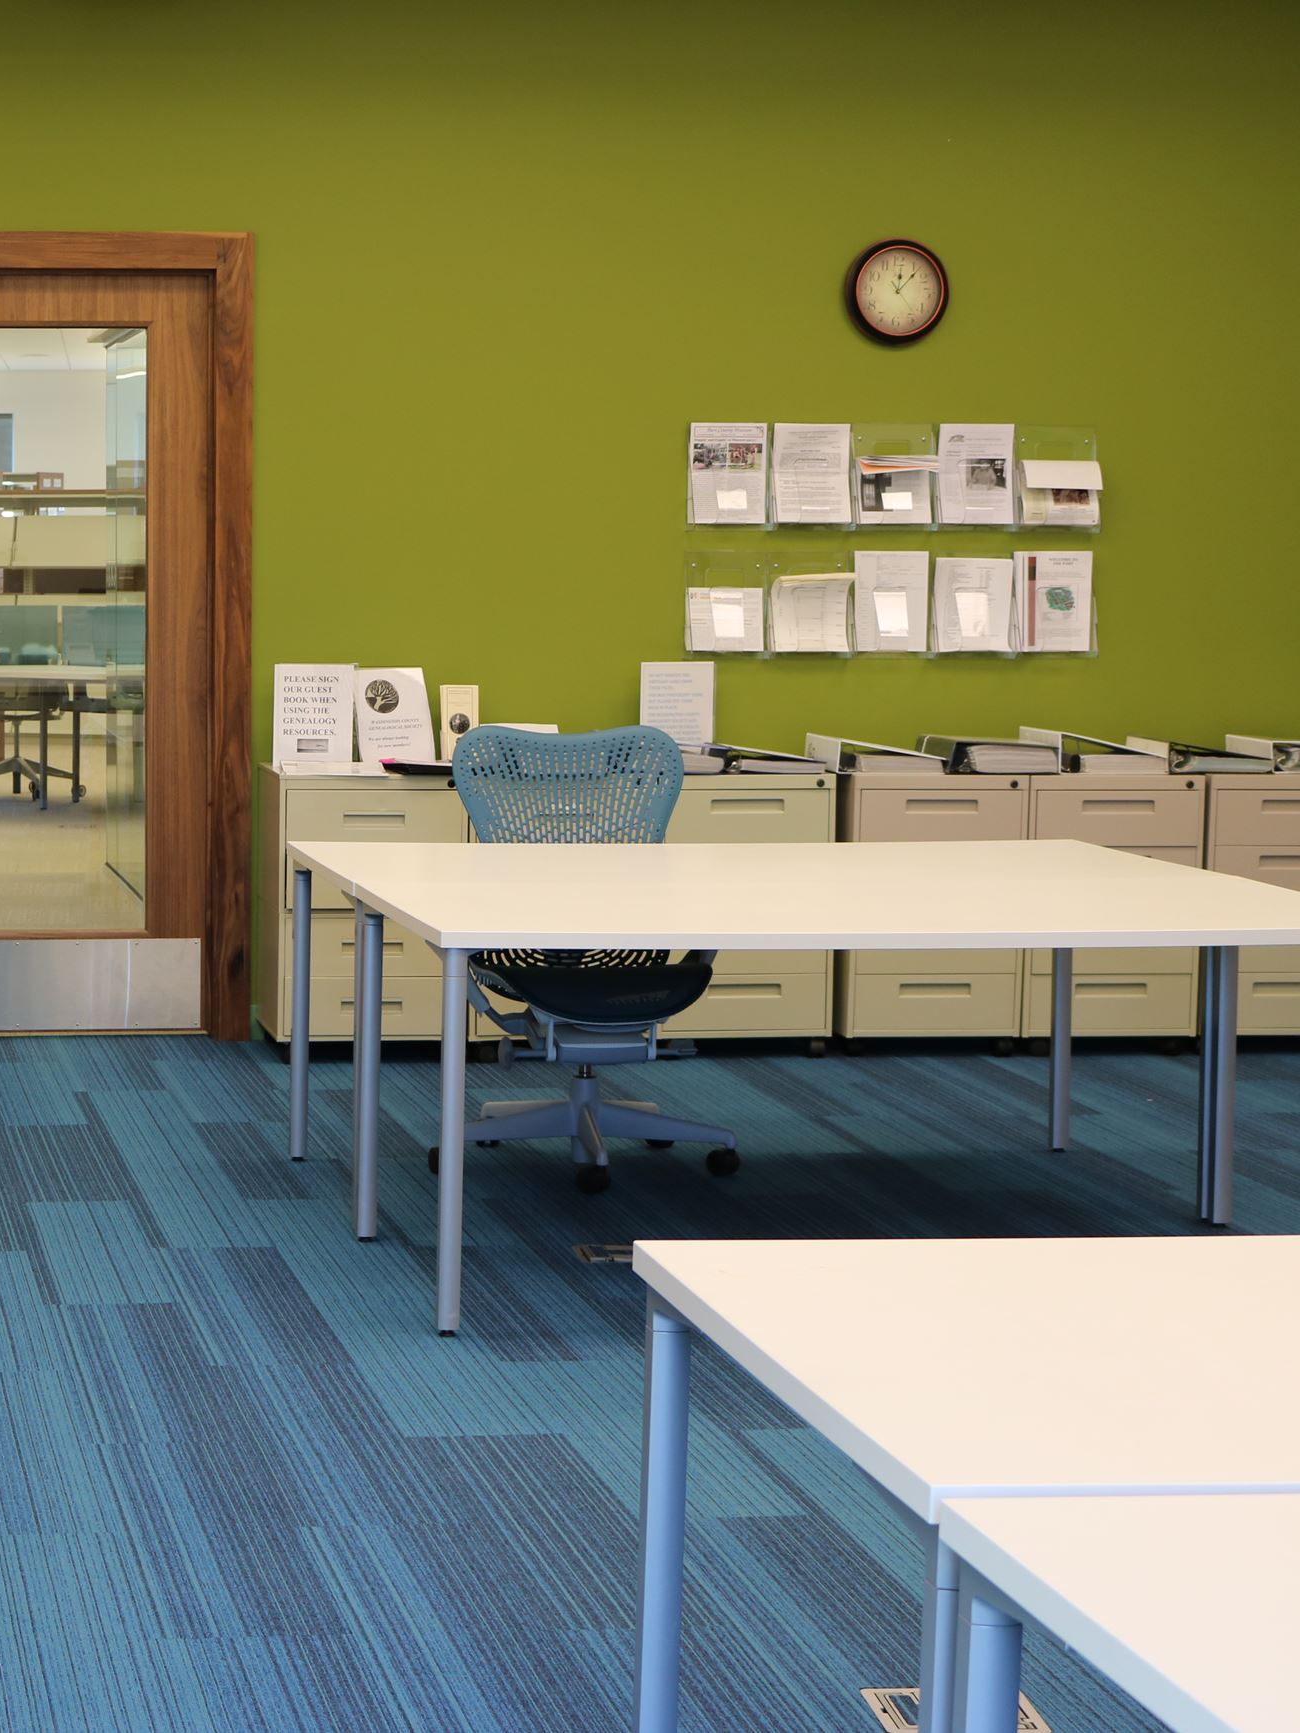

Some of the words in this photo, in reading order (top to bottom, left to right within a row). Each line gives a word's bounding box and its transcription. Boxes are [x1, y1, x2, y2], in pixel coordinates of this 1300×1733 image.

[882, 261, 889, 271] 11
[893, 255, 905, 267] 12
[869, 271, 881, 282] 10
[920, 272, 928, 284] 2
[865, 286, 873, 296] 9
[868, 300, 876, 311] 8
[916, 302, 924, 314] 4
[891, 316, 900, 327] 6
